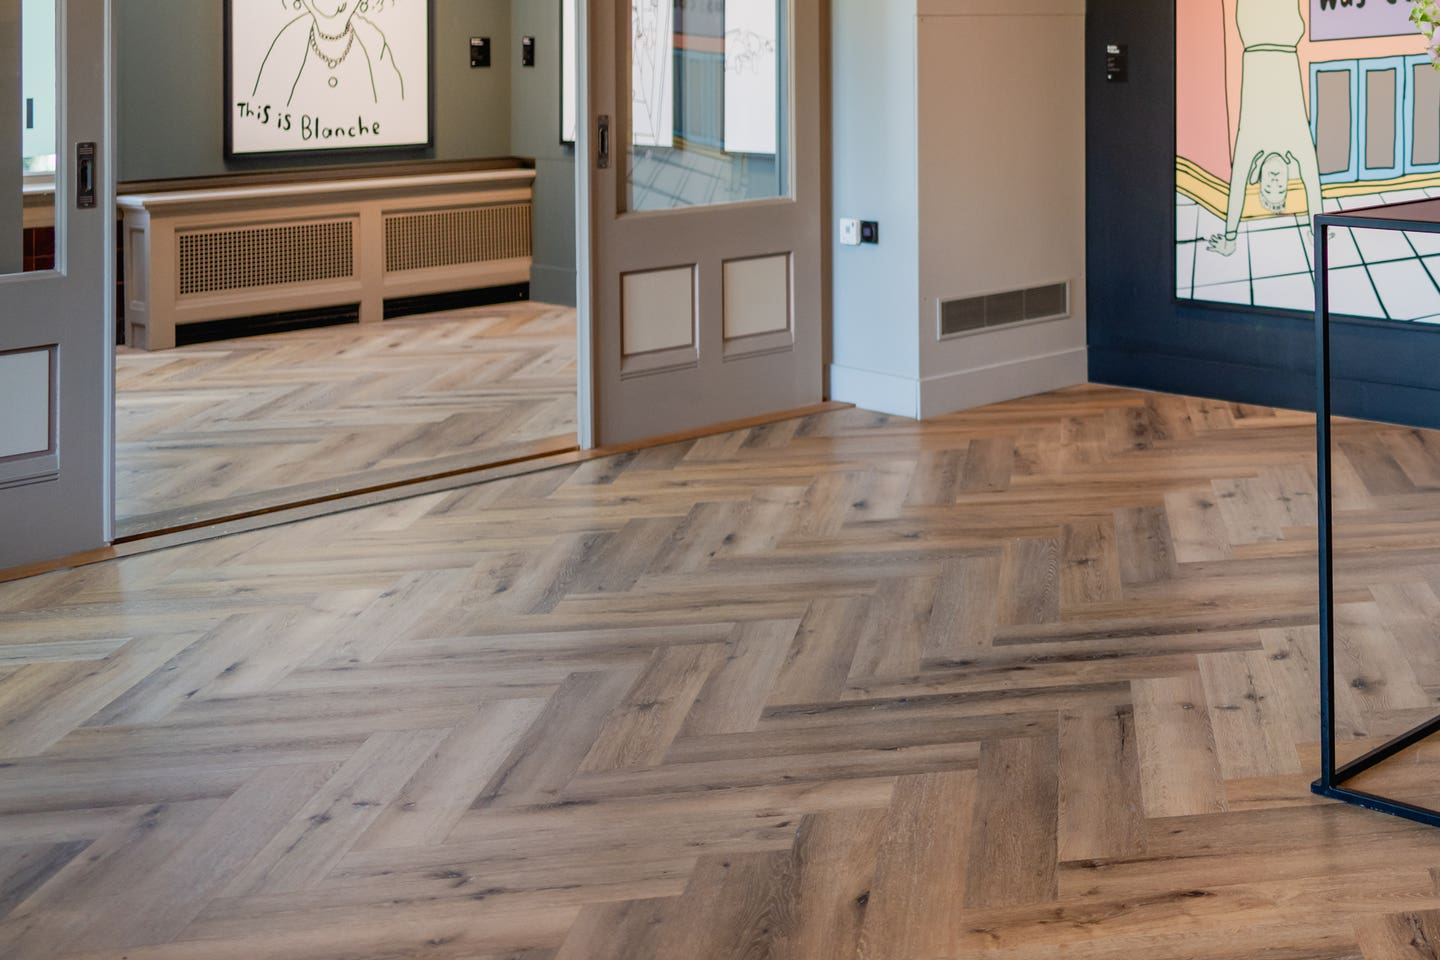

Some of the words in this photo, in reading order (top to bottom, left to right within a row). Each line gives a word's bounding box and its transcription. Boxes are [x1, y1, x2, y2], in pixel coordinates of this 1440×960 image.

[237, 102, 271, 124] This
[277, 113, 291, 131] is
[301, 114, 380, 141] Blanche
